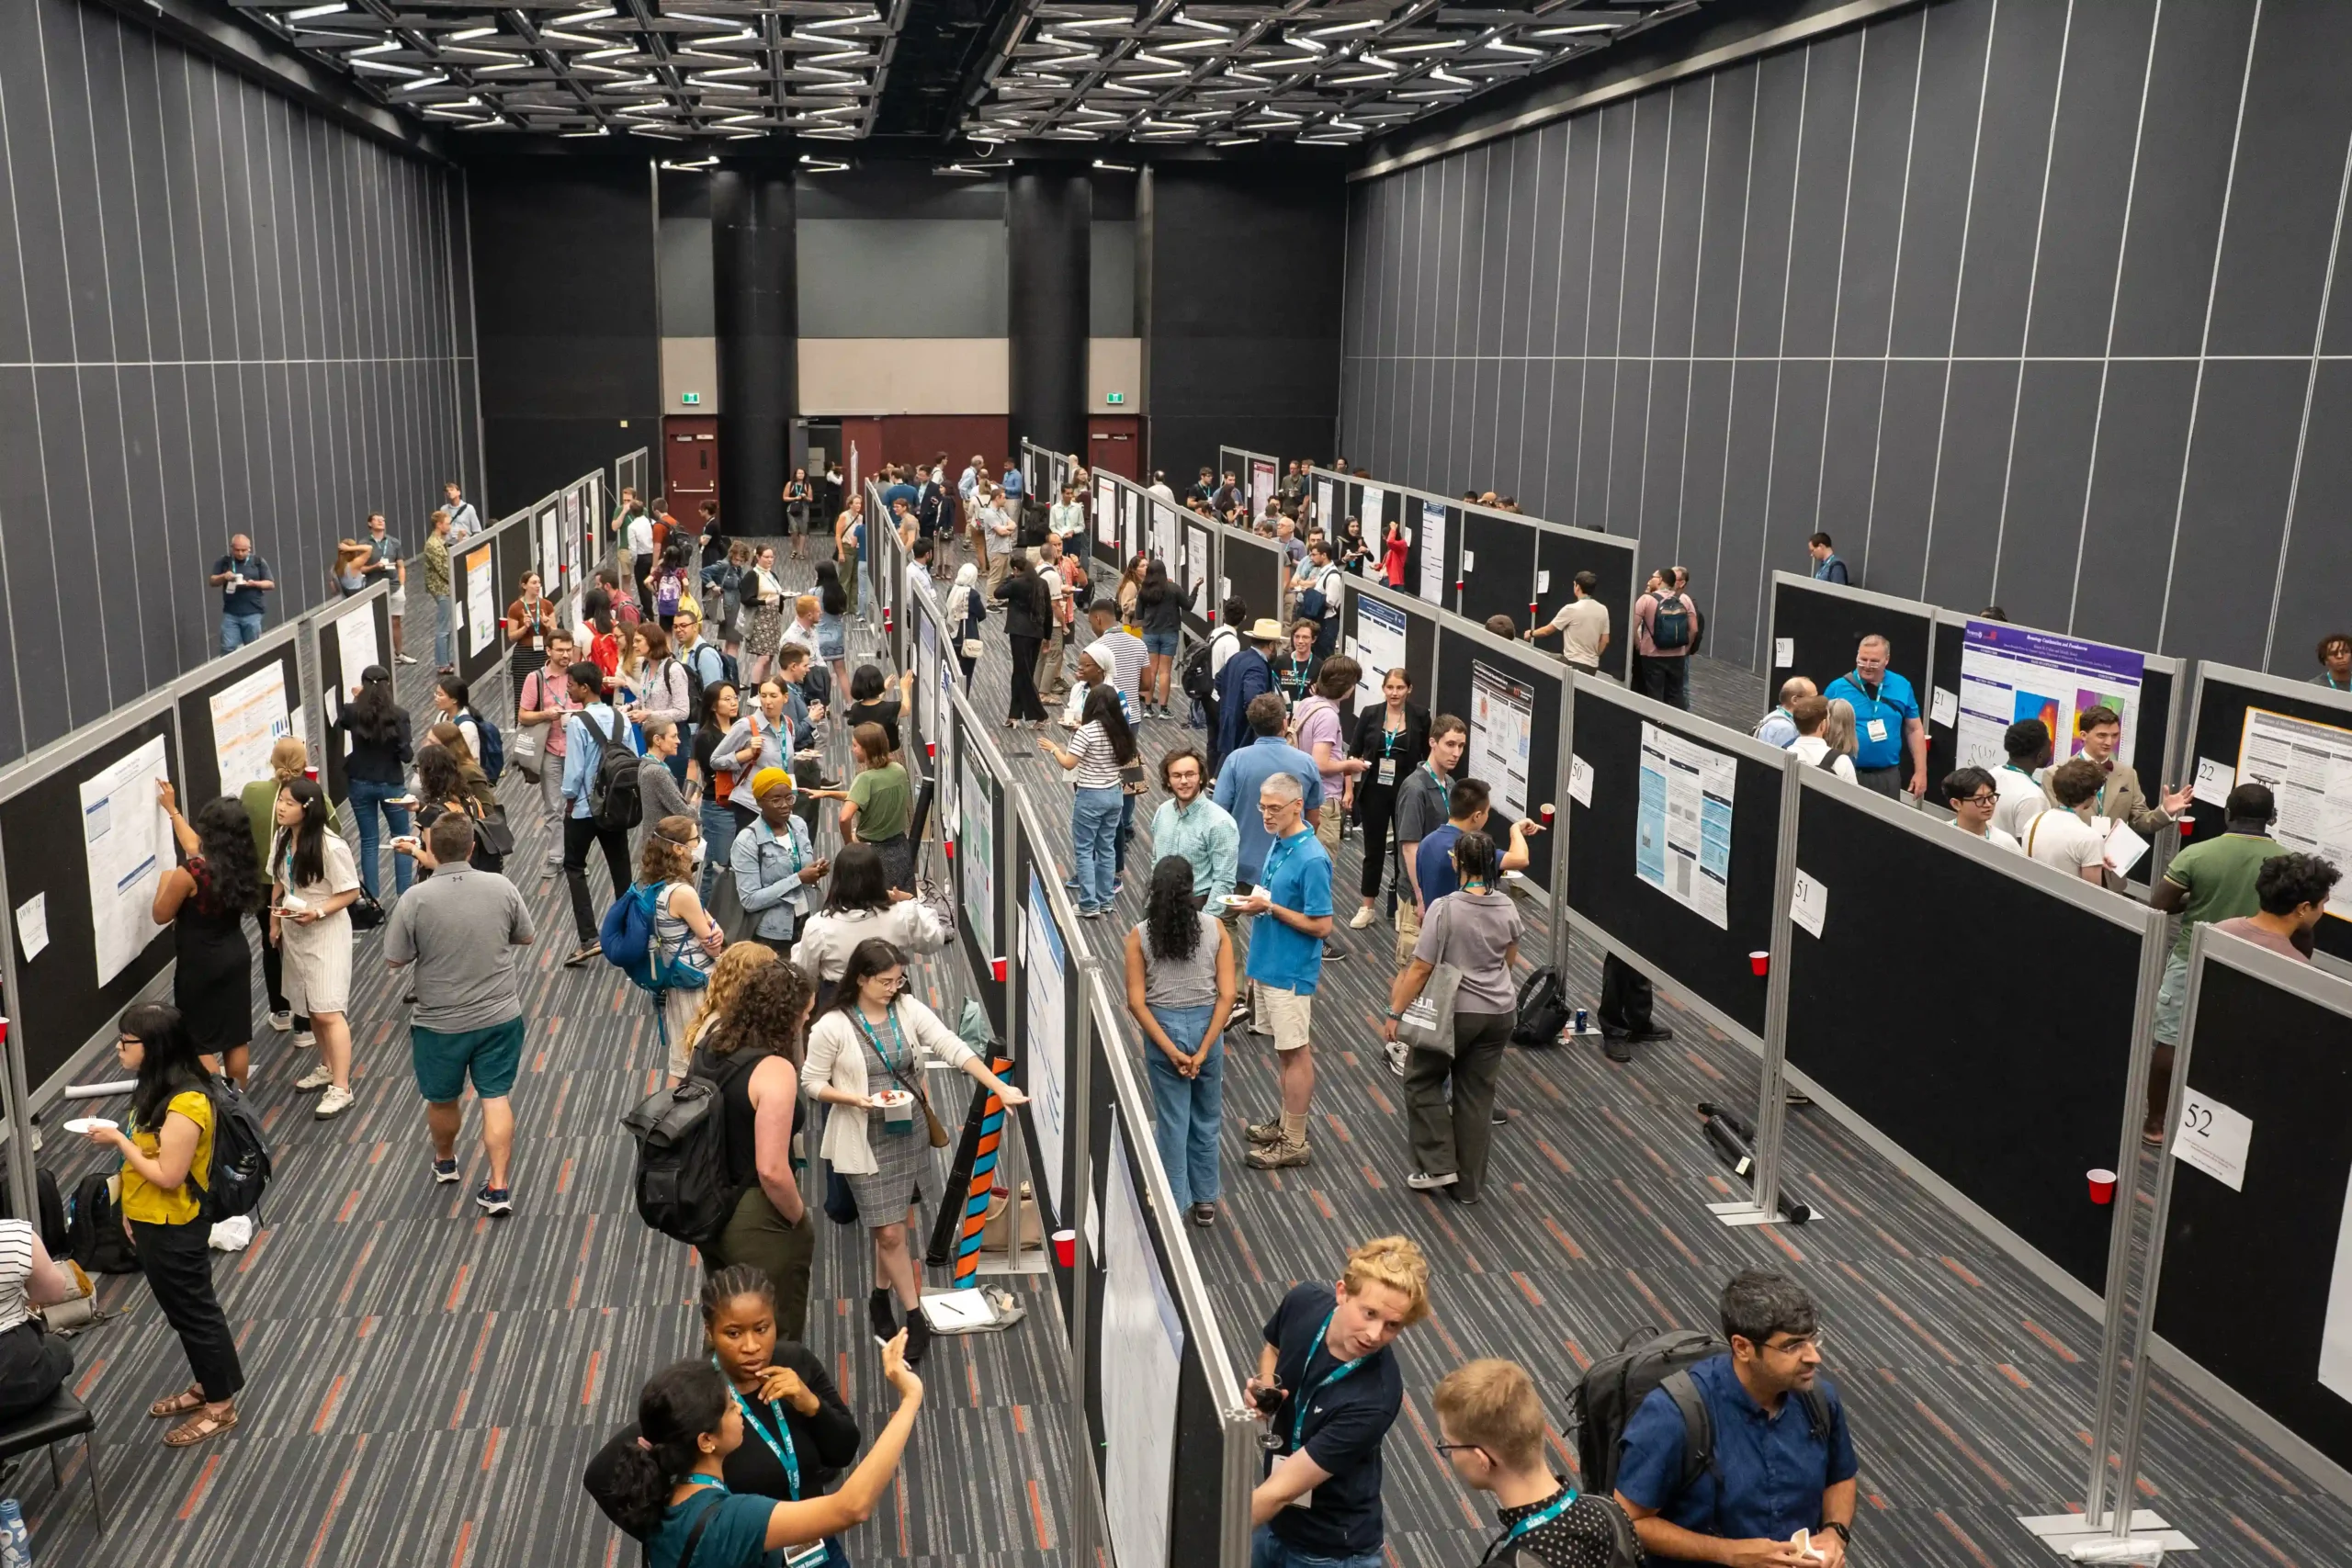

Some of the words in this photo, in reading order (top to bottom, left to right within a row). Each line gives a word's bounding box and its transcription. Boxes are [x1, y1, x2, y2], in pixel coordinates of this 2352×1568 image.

[1934, 691, 1944, 706] 21
[1572, 762, 1583, 781] 50
[2199, 762, 2214, 782] 22
[1795, 879, 1808, 903] 51
[2184, 1102, 2212, 1138] 52
